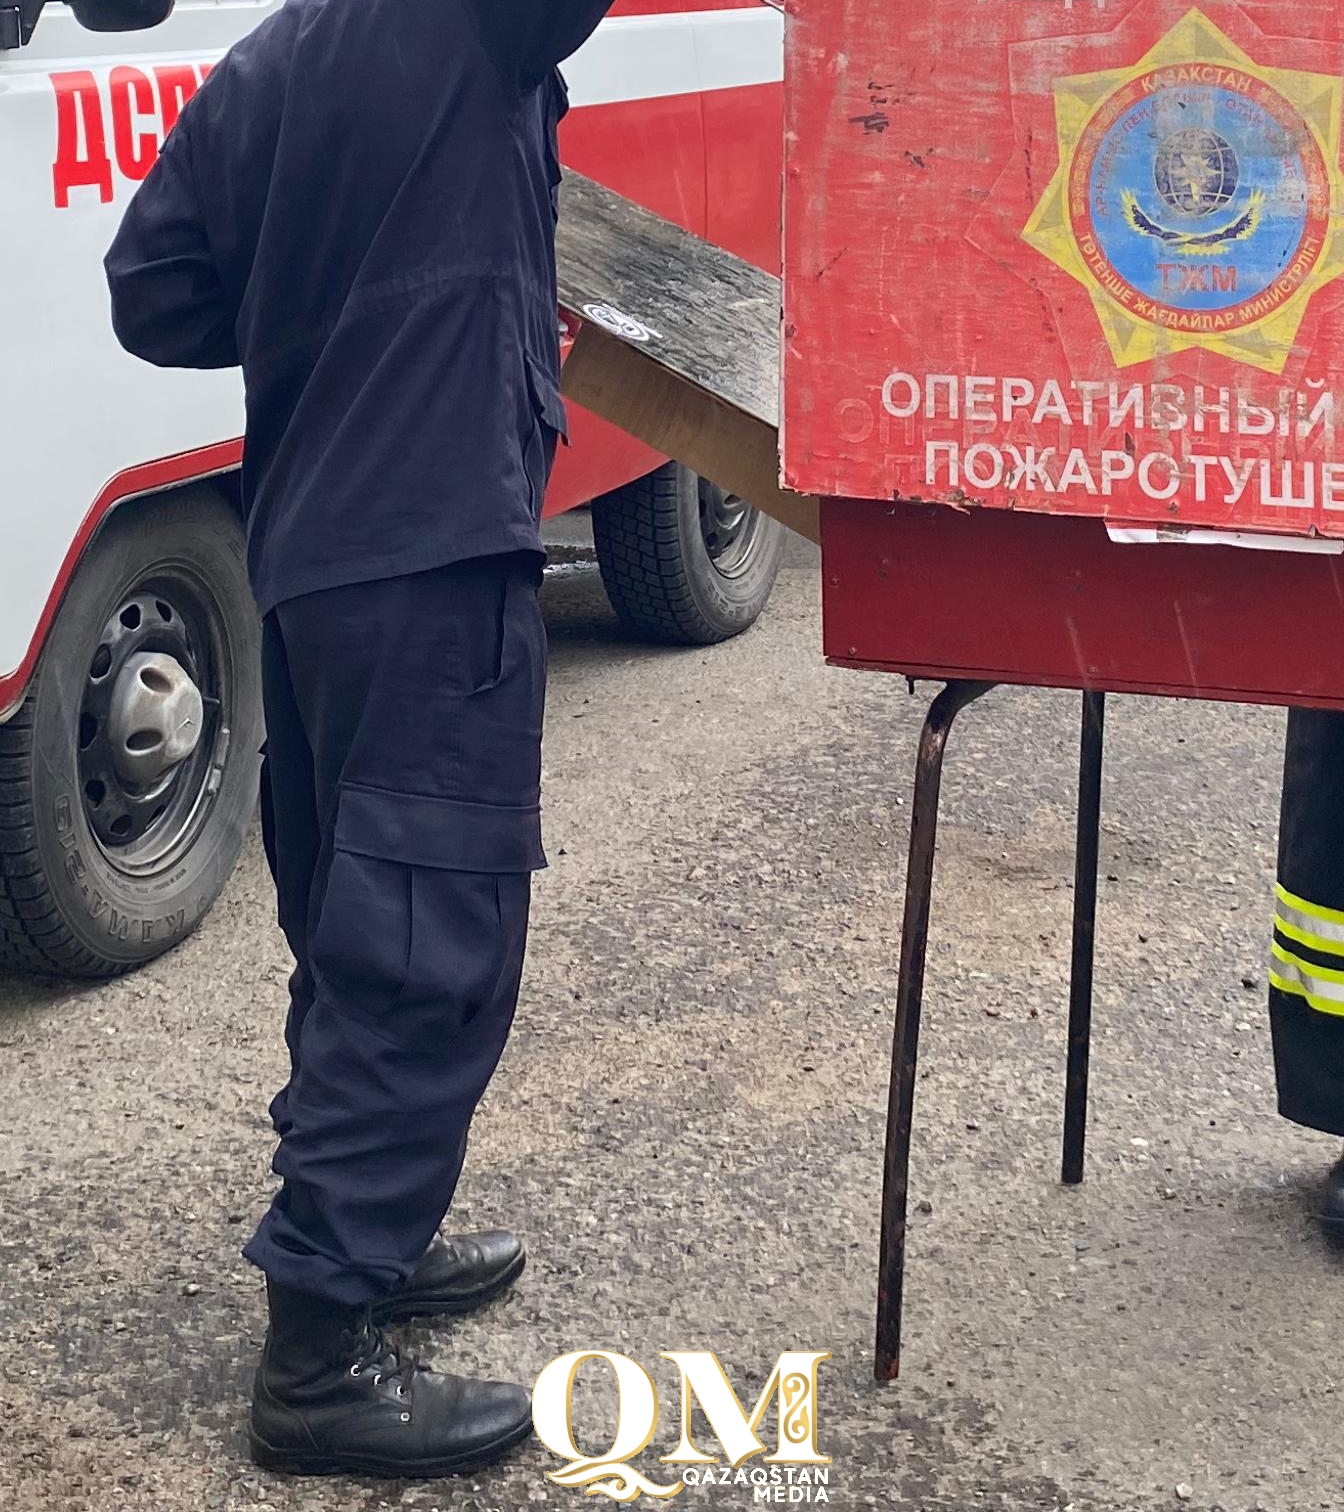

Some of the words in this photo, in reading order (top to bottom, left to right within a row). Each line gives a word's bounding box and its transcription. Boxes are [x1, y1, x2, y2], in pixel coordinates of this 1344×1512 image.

[48, 64, 214, 209] ДСП
[1080, 232, 1134, 304] ТӨТЕНШЕ
[1156, 263, 1238, 293] ТЖМ
[882, 372, 1335, 437] ОПЕРАТИВНЫЙ
